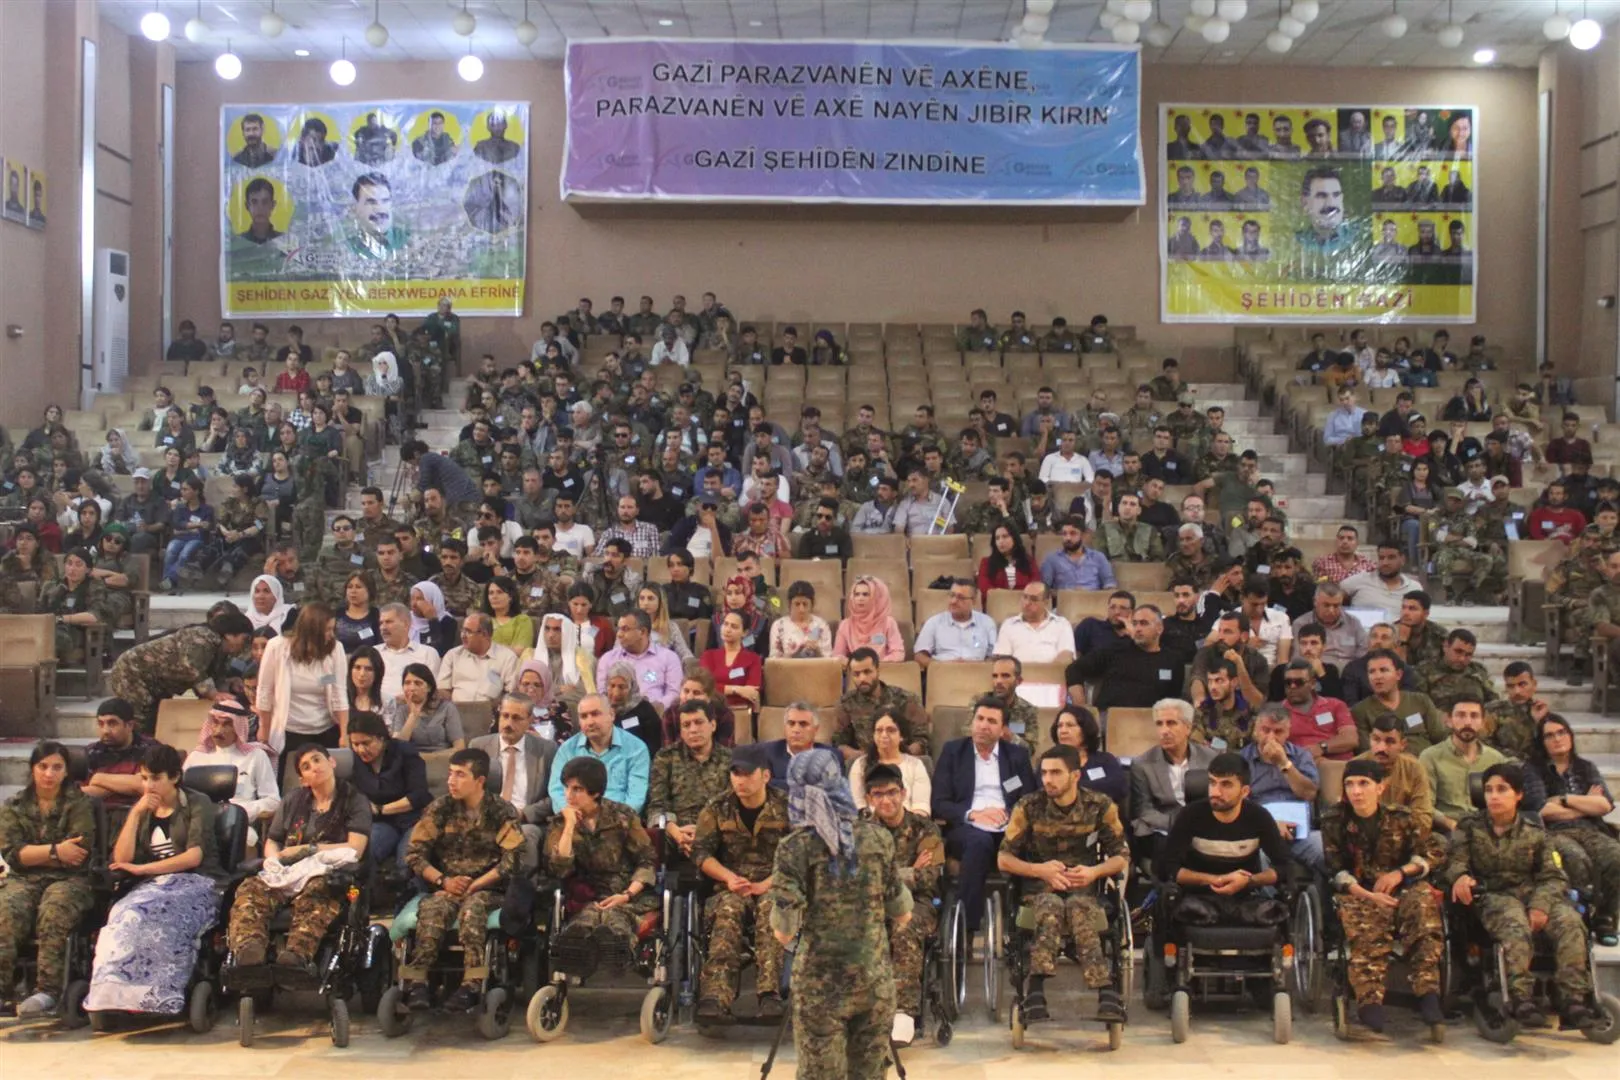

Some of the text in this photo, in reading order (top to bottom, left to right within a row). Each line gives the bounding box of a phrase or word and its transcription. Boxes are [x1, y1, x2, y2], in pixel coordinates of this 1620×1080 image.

[652, 58, 711, 83] GAZÎ
[720, 62, 893, 86] PARAZVANÊN
[902, 64, 934, 87] VÊ
[942, 66, 1035, 94] AXÊNE,
[597, 93, 1109, 125] PARAZVANÊN VÊ AXÊ NAYÊN JIBÎR KIRIN
[695, 147, 755, 168] GAZÎ
[764, 147, 876, 172] ŞEHÎDÊN
[884, 150, 986, 174] ZINDÎNE
